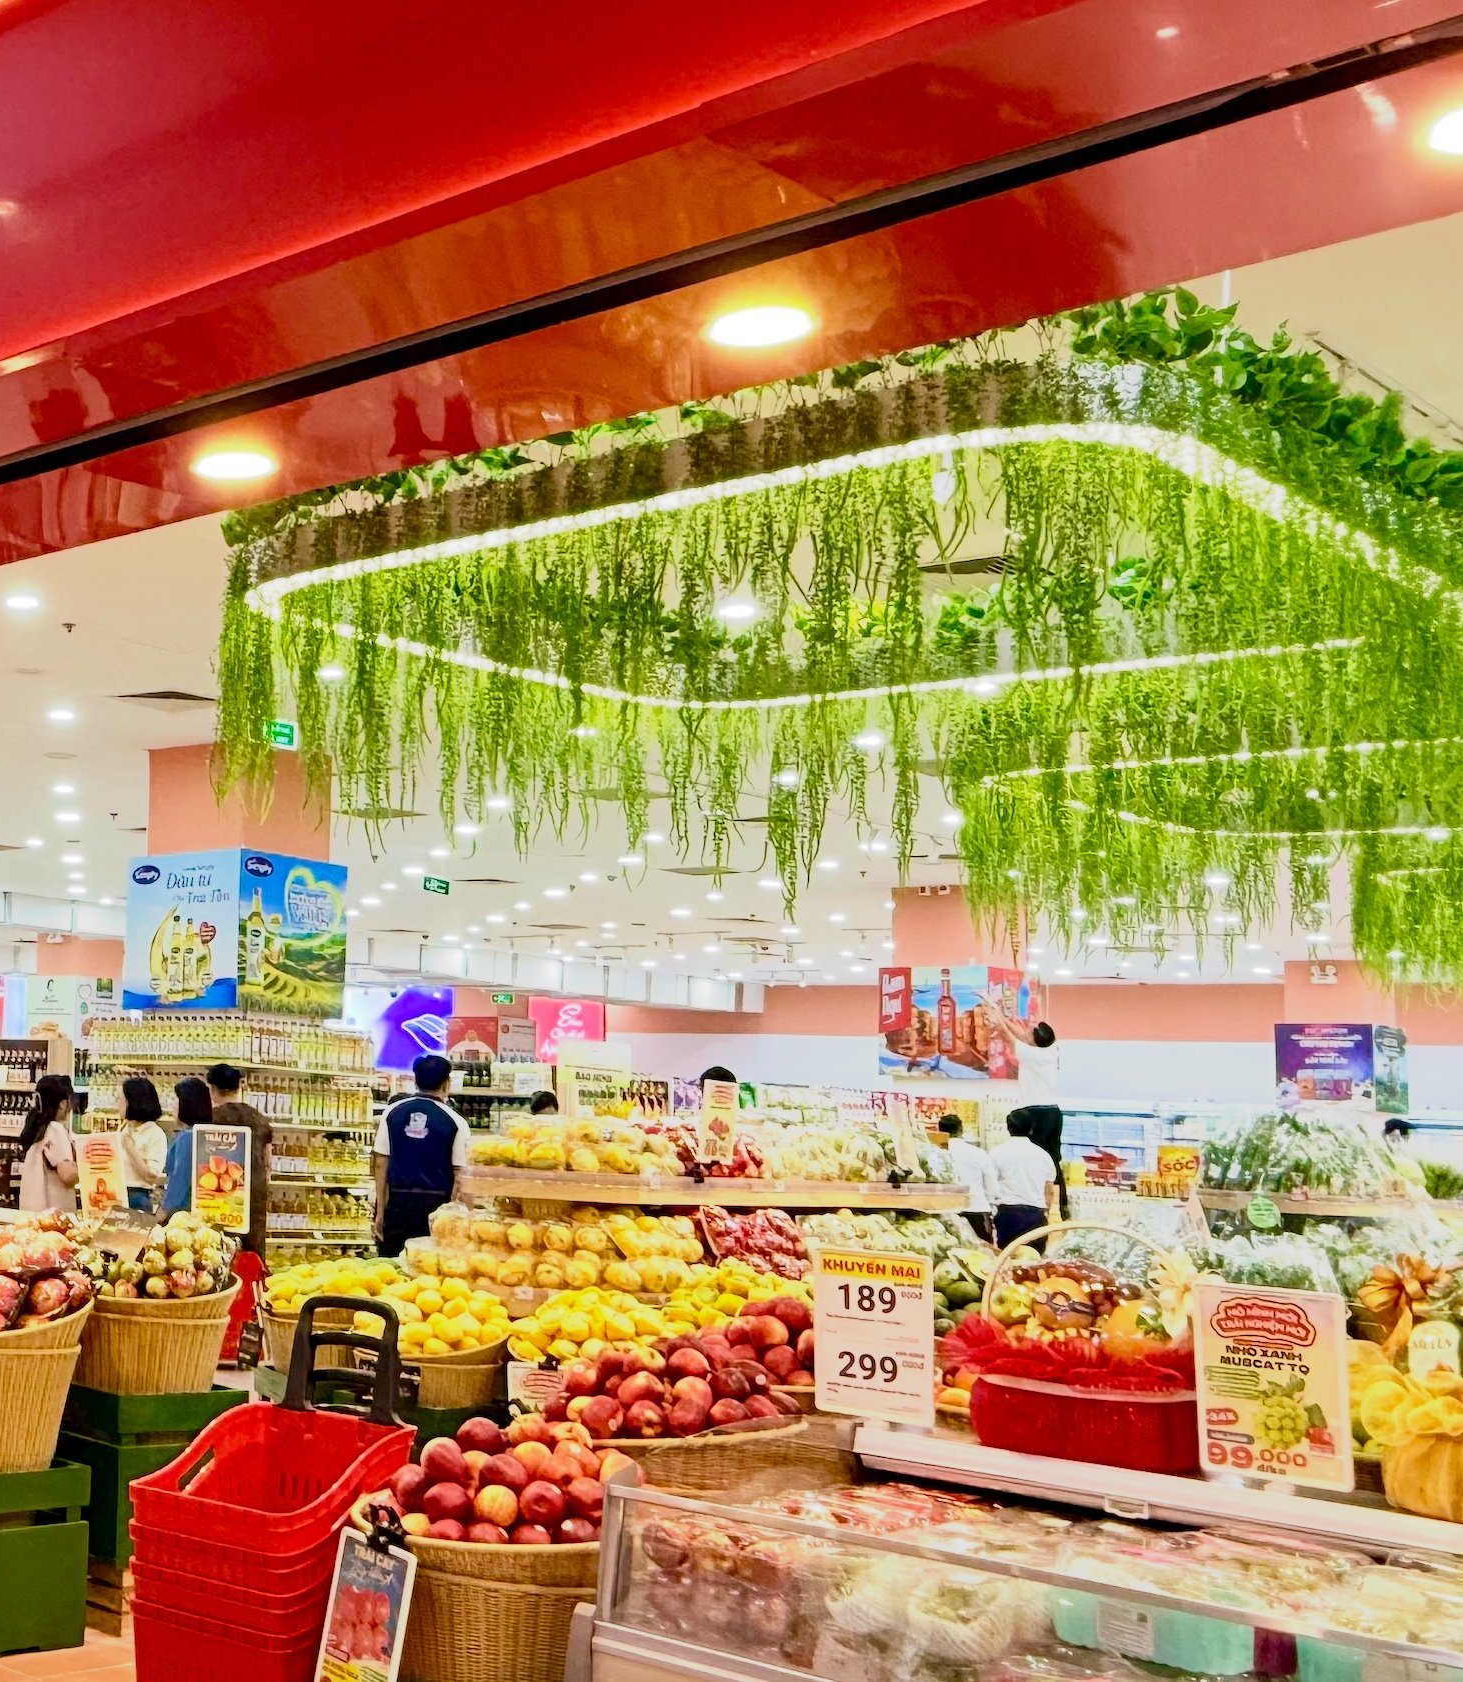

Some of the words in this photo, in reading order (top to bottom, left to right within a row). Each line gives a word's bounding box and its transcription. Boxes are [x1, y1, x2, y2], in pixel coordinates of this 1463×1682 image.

[891, 1265, 921, 1282] MẠI
[838, 1283, 897, 1314] 189
[838, 1350, 898, 1383] 299
[1226, 1345, 1257, 1357] NHO
[1260, 1348, 1302, 1361] XANH
[1208, 1442, 1307, 1469] 99.000
